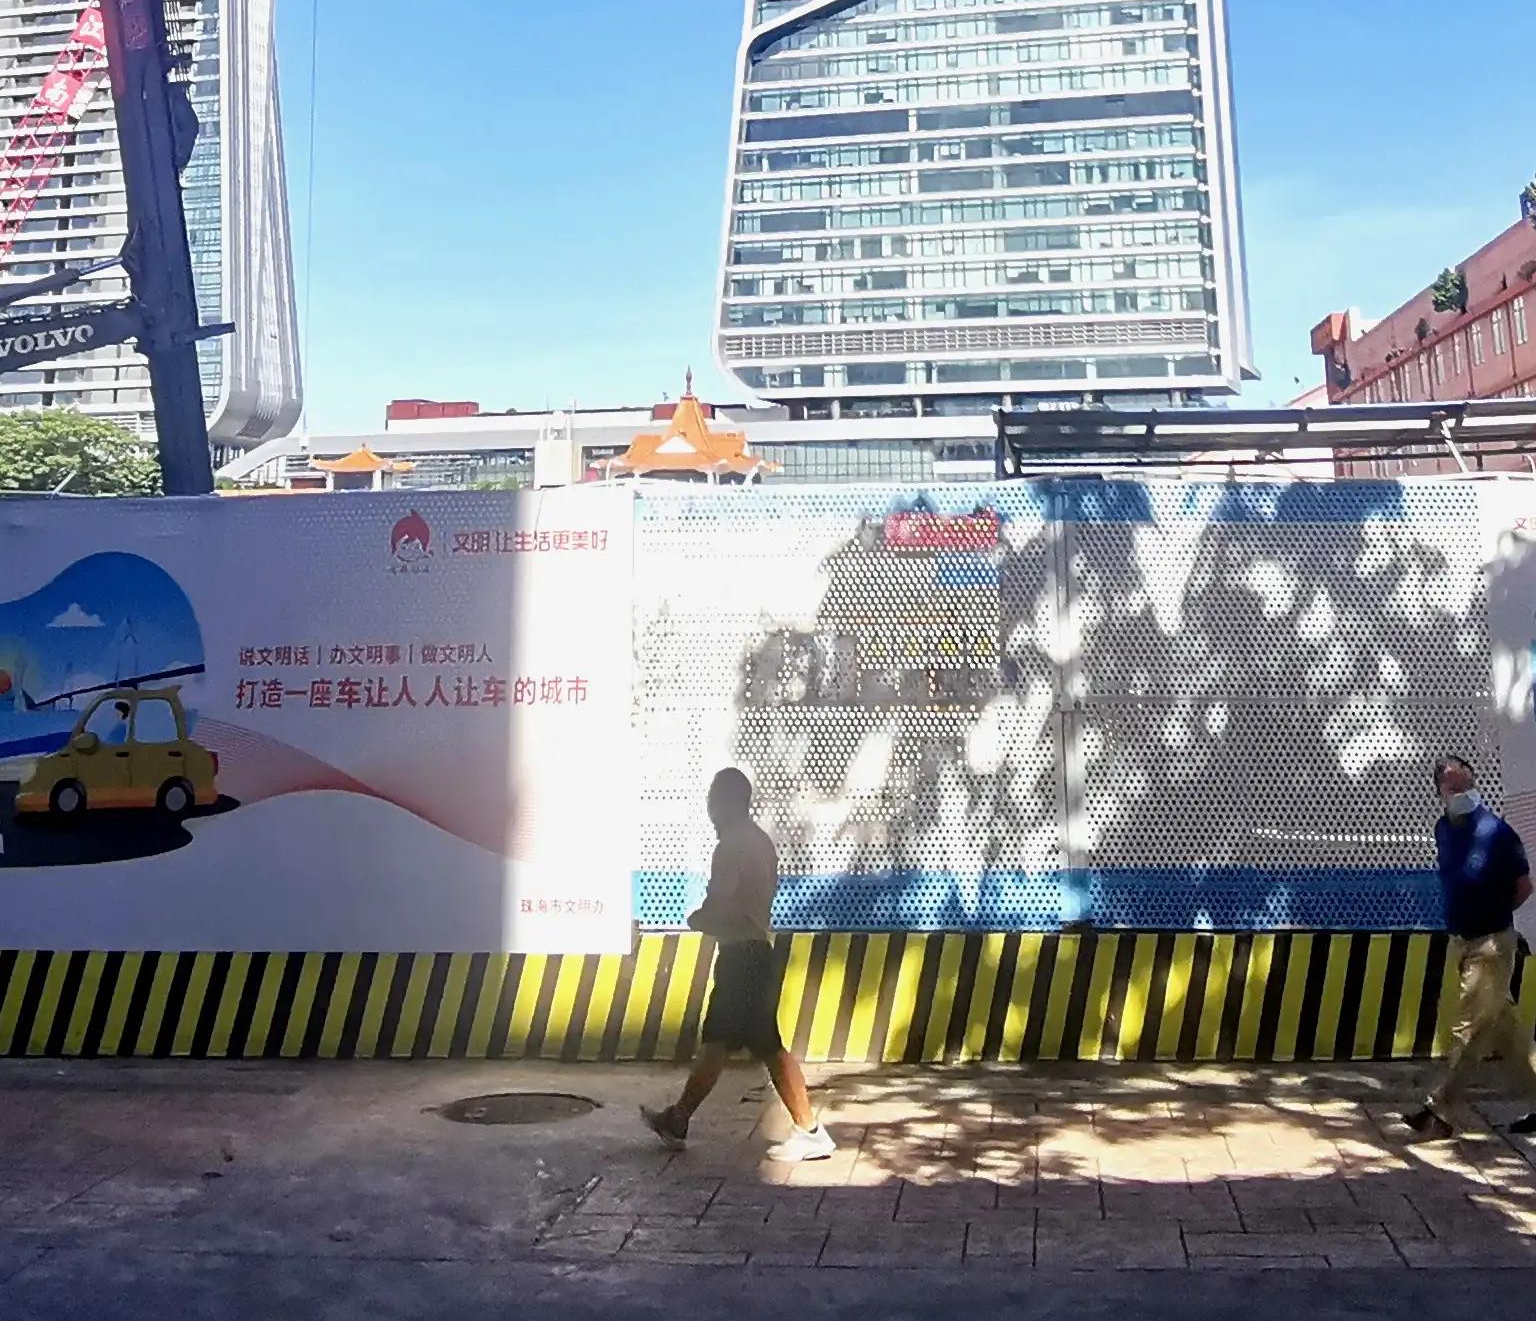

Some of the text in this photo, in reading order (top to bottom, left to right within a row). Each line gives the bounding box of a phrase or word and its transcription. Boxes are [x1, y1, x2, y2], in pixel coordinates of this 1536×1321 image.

[239, 643, 493, 666] 说文明话 办文明事 做文明人
[235, 676, 589, 709] 打造一座车让人人让车的城市
